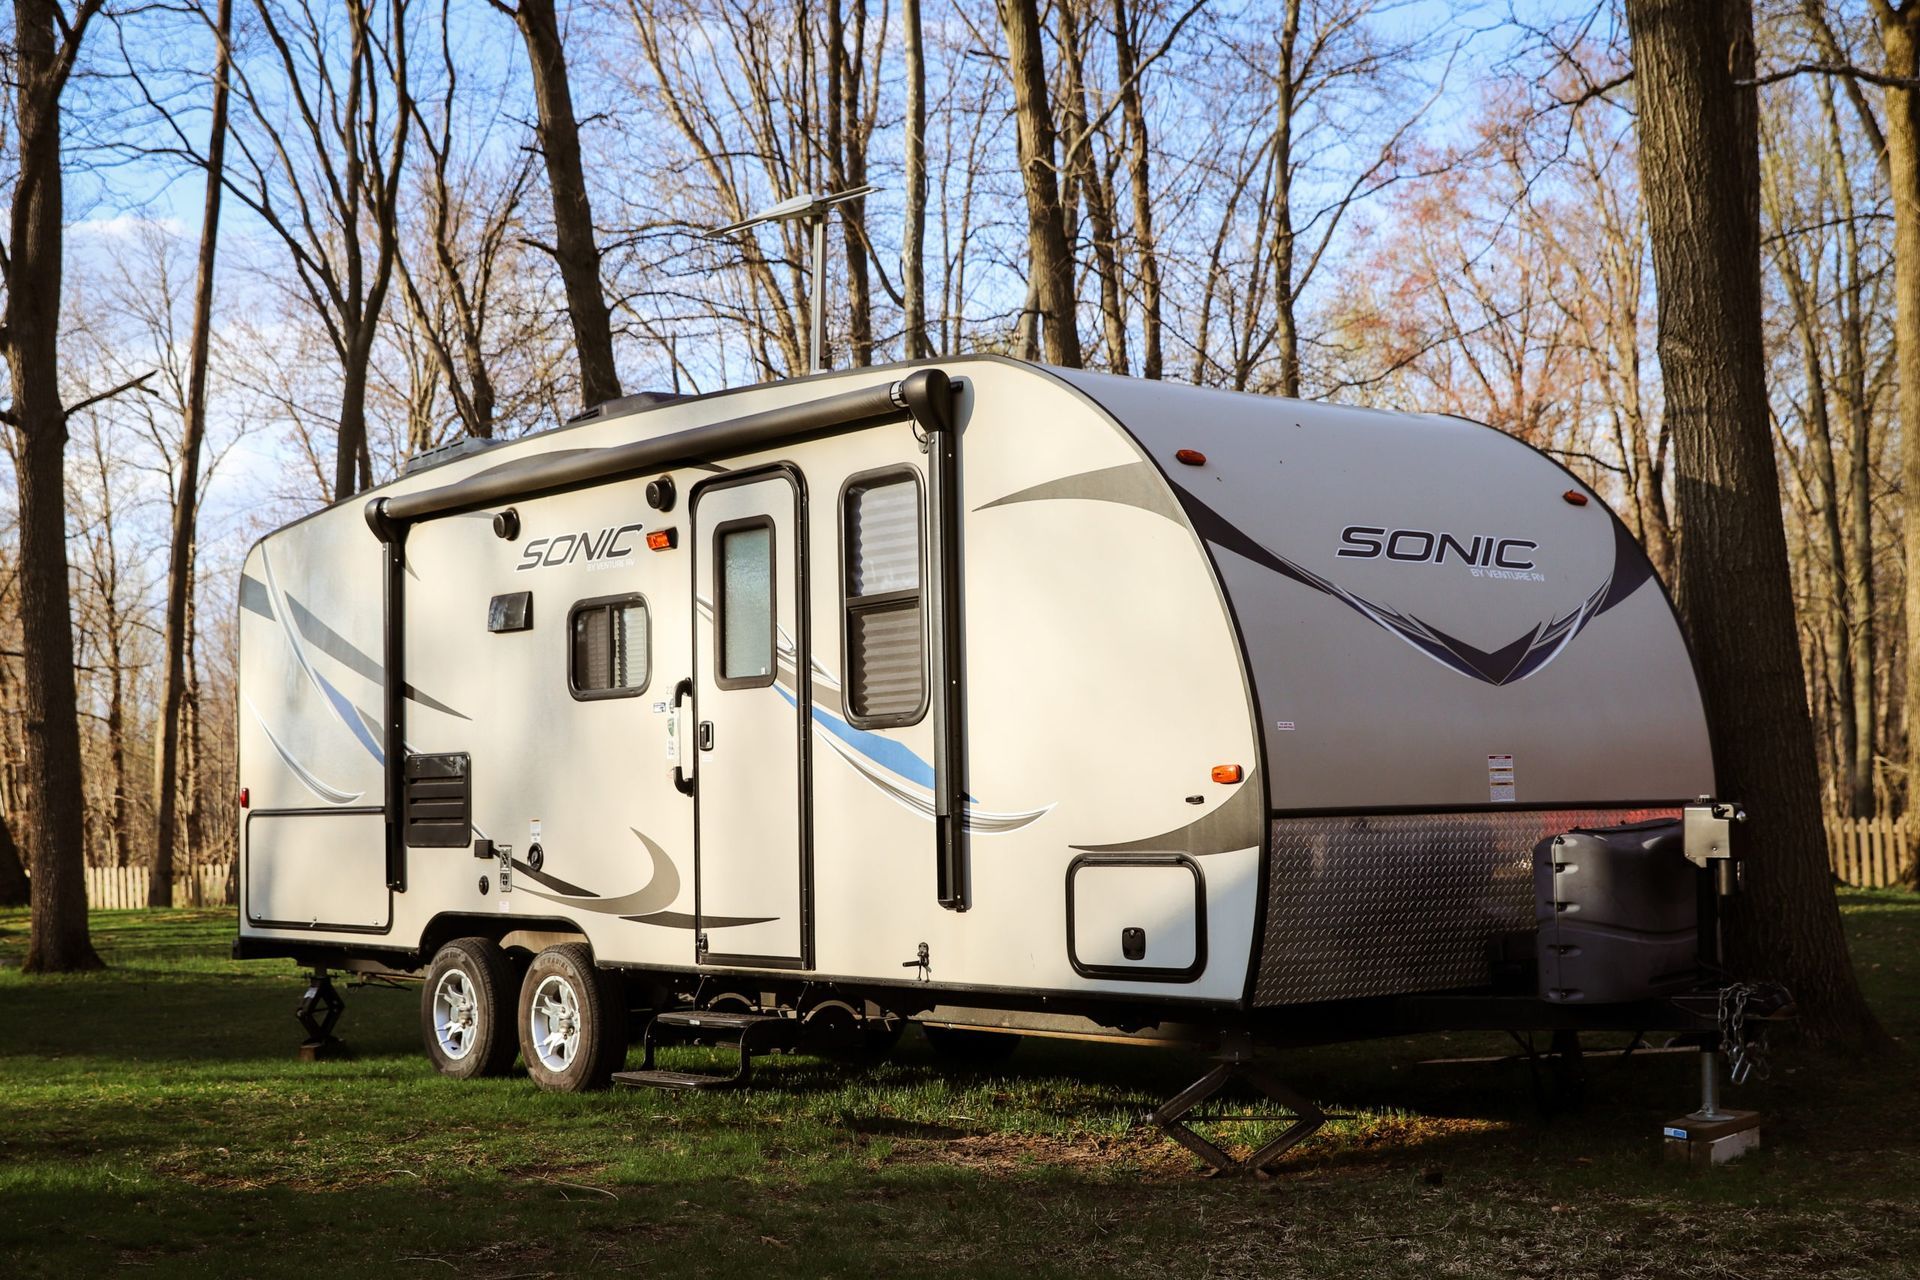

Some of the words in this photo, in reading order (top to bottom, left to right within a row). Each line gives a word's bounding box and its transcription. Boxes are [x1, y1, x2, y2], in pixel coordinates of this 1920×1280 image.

[515, 522, 643, 571] SONIC
[1336, 525, 1539, 570] SONIC
[1470, 568, 1485, 577] BY
[1486, 569, 1532, 581] VENTURE
[1532, 573, 1545, 582] RV
